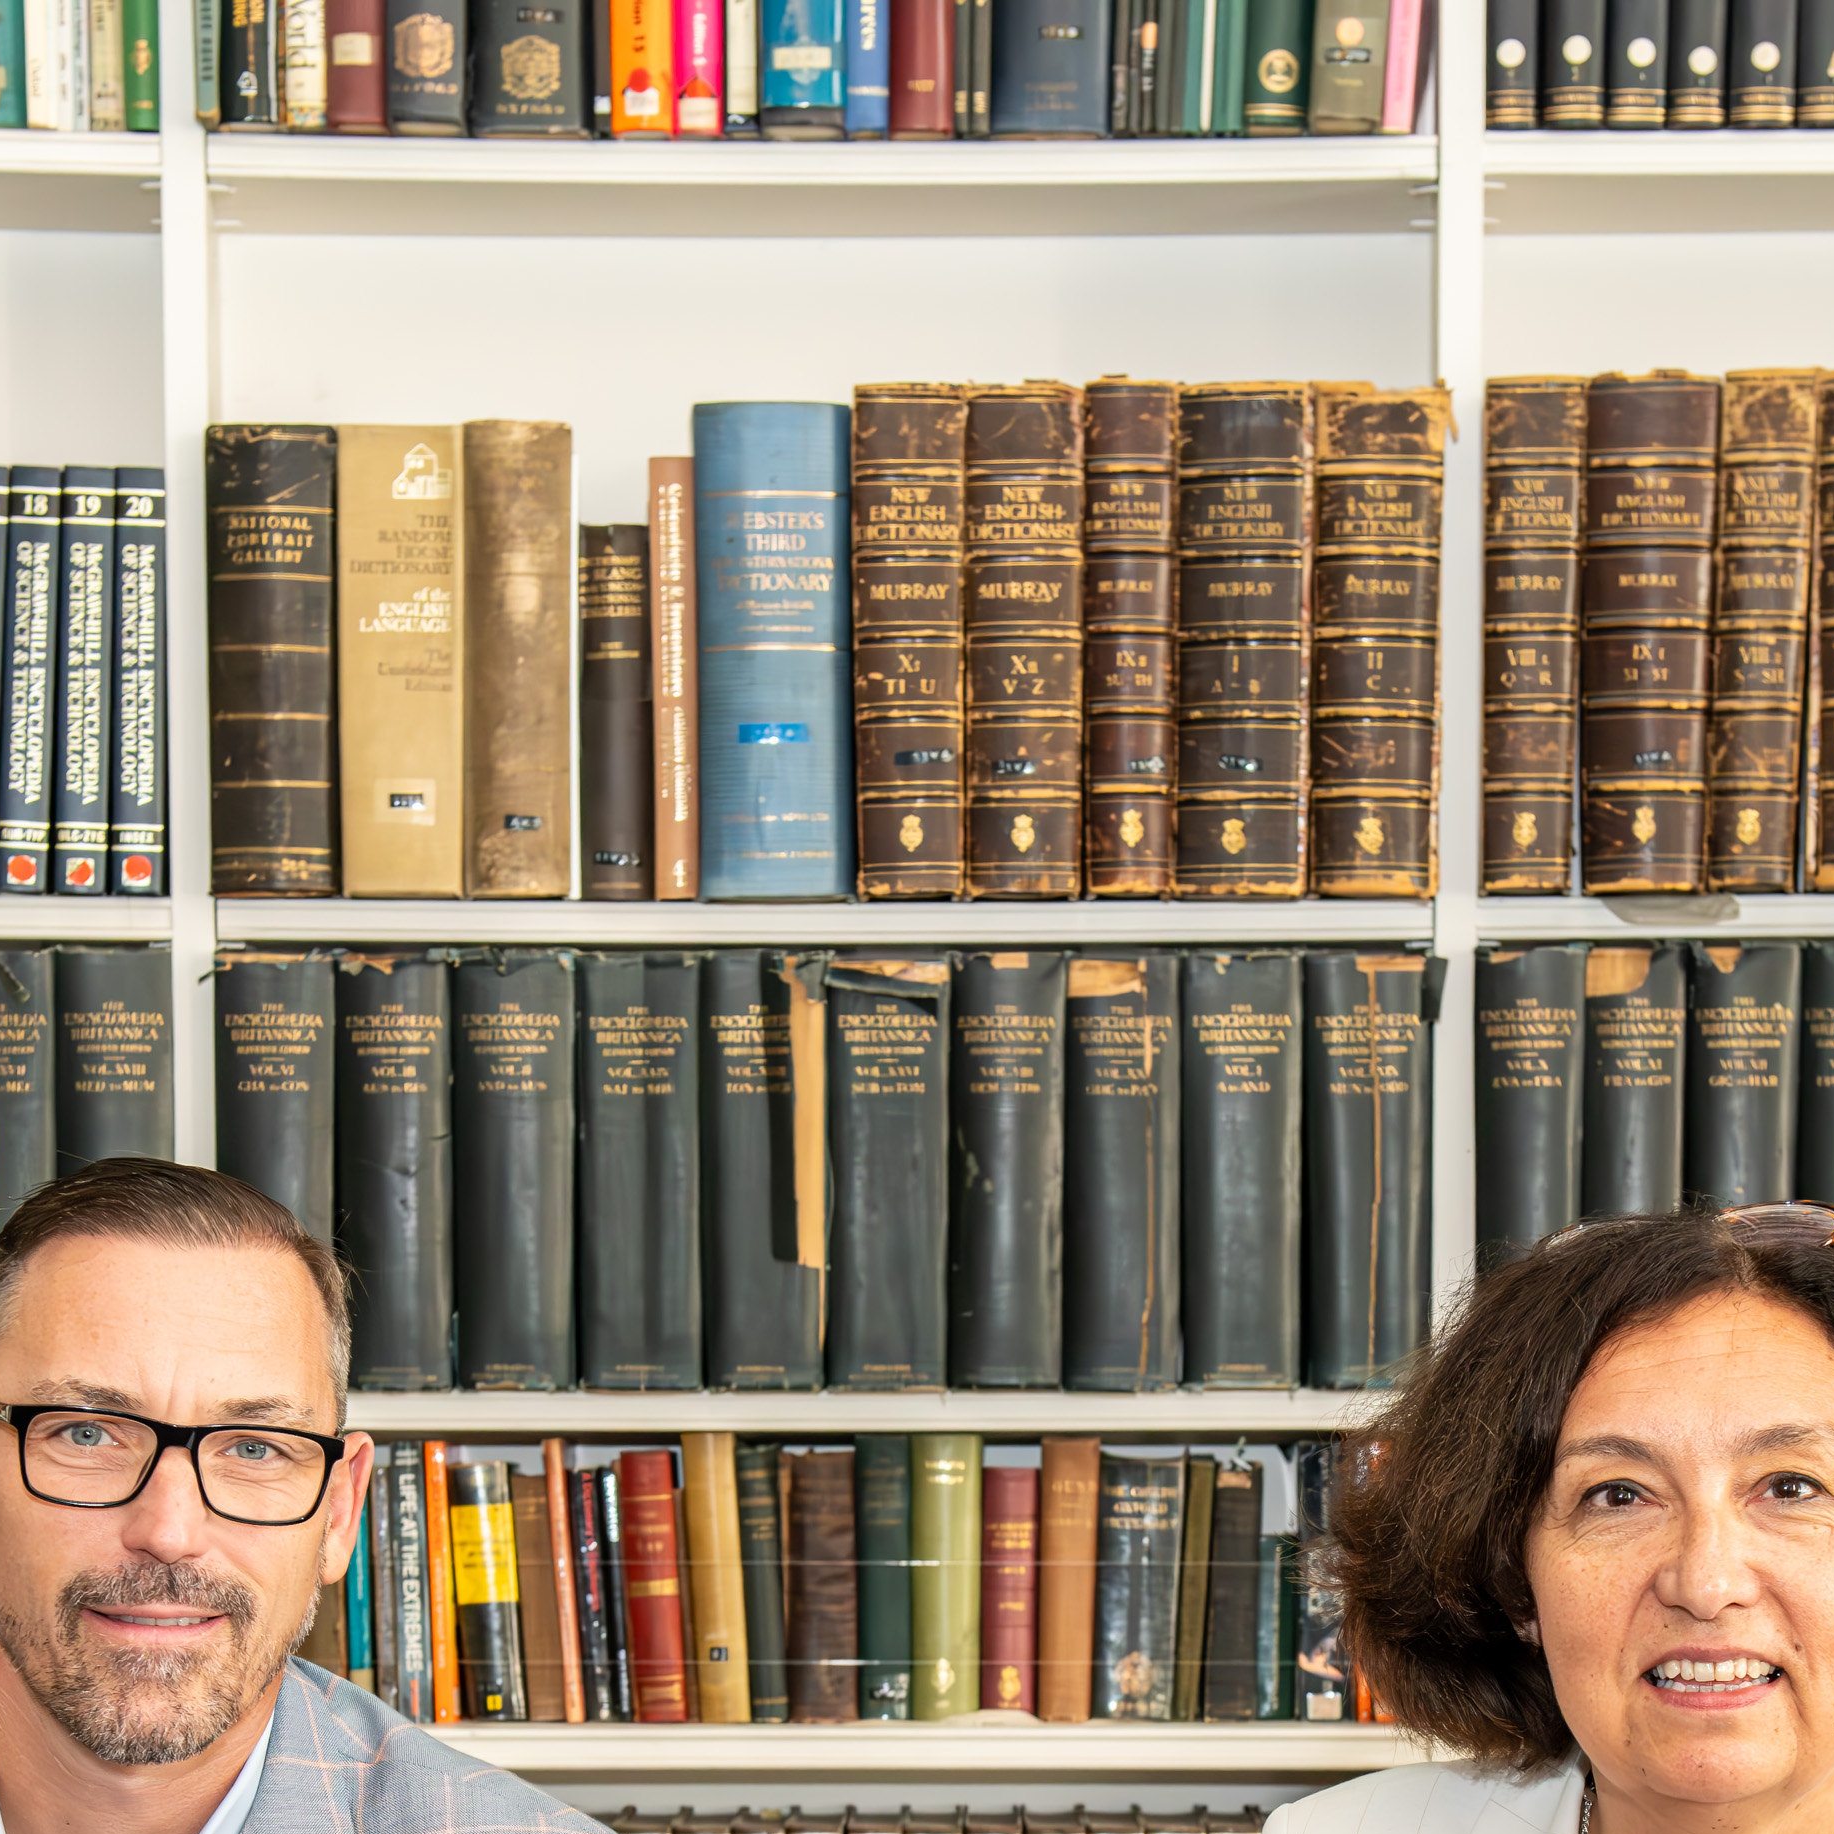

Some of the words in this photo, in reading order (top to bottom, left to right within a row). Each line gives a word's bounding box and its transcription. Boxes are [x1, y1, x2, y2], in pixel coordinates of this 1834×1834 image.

[890, 486, 932, 503] NEW
[1001, 487, 1043, 502] NEW
[23, 494, 48, 515] 18
[74, 495, 101, 516] 19
[126, 496, 153, 517] 20
[984, 504, 1061, 520] ENGLISH
[229, 514, 313, 531] NATIONAL
[869, 506, 946, 522] ENGLISH
[378, 529, 453, 545] RANDOM
[857, 523, 960, 540] DICTIONARY
[968, 522, 1078, 540] DICTIONARY
[227, 532, 315, 549] PORTRAIT
[744, 533, 806, 551] THIRD
[122, 544, 138, 570] OF
[232, 548, 303, 564] GALLERY
[349, 560, 454, 576] DICTIONARY
[870, 583, 951, 600] MURRAY
[978, 582, 1062, 600] MURRAY
[121, 571, 138, 650] SCIENCE
[378, 602, 452, 618] ENGLISH
[359, 617, 453, 633] LANGUAGE
[121, 652, 137, 667] &
[120, 669, 137, 796] TECHNOLOGY
[398, 1473, 417, 1513] LIFE
[400, 1517, 419, 1537] AT
[401, 1543, 420, 1577] THE
[403, 1579, 424, 1673] EXTREMES
